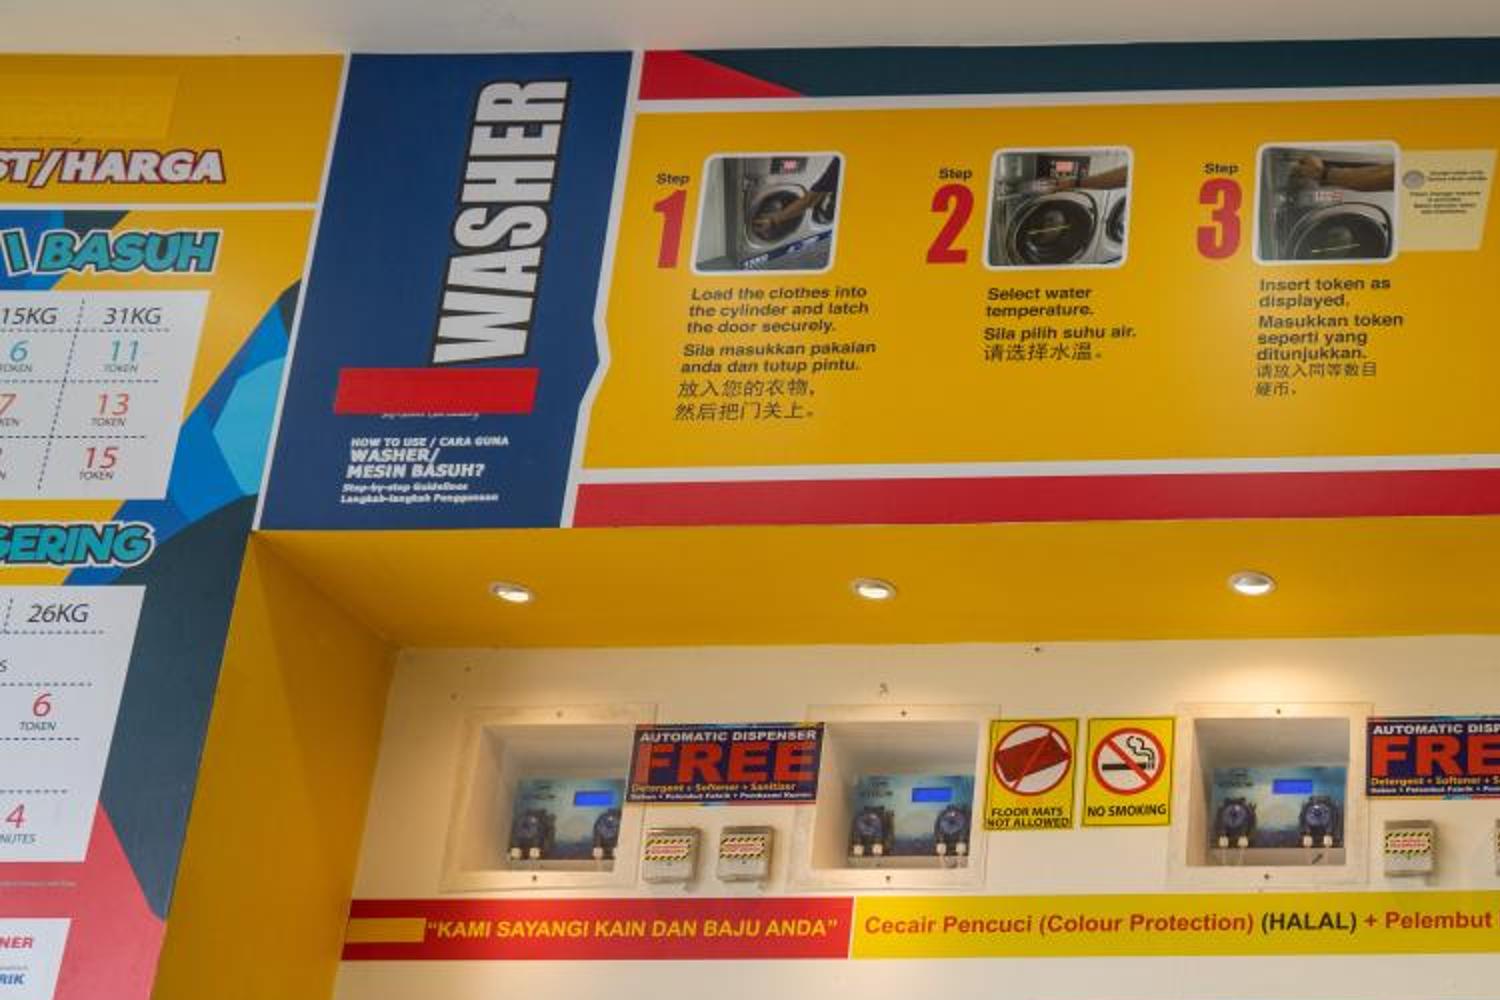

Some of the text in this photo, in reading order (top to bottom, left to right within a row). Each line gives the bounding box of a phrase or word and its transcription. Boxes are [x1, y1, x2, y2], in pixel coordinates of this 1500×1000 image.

[939, 168, 972, 180] Step
[1204, 164, 1239, 175] Step
[656, 173, 689, 187] Step
[431, 80, 569, 364] WASHER
[926, 183, 974, 264] 2
[1197, 178, 1243, 261] 3
[654, 189, 687, 268] 1
[35, 230, 221, 274] BASUH
[1260, 278, 1391, 291] Insert token as
[692, 286, 867, 300] Load the clothes into
[988, 288, 1091, 300] Select water
[1259, 294, 1349, 309] displayed.
[2, 308, 161, 325] 15KG 31KG
[689, 302, 868, 319] the cylinder and latch
[987, 305, 1093, 319] temperature.
[687, 321, 835, 335] the door securely.
[1259, 314, 1402, 328] Masukkan token
[984, 326, 1136, 342] Sila pilih suhu air.
[1258, 332, 1367, 346] seperti yang
[10, 340, 139, 362] 6 11
[684, 341, 876, 356] Sila masukkan pakaian
[1257, 348, 1366, 363] ditunjukkan.
[681, 357, 859, 374] anda dan tutup pintu.
[99, 393, 129, 415] 13
[352, 438, 381, 446] HOW
[384, 438, 400, 446] TO
[404, 437, 426, 446] USE
[440, 437, 471, 446] CARA
[475, 436, 509, 446] GUNA
[86, 448, 118, 468] 15
[352, 448, 440, 463] WASHER/
[80, 472, 114, 480] TOKEN
[346, 463, 485, 478] MESIN BASUH?
[28, 603, 89, 623] 26KG
[640, 730, 816, 742] AUTOMATIC DISPENSER
[1374, 724, 1463, 735] AUTOMATIC
[633, 741, 816, 784] FREE
[992, 807, 1063, 817] FLOOR MATS
[1088, 804, 1166, 817] NO SMOKING
[988, 817, 1069, 828] NOT ALLOWED
[497, 921, 589, 938] SAYANGI
[594, 920, 645, 937] KAIN
[651, 920, 697, 937] DAN
[704, 920, 760, 937] BAJU
[865, 916, 935, 935] Cecair
[943, 915, 1033, 934] Pencuci
[1039, 913, 1122, 936] (Colour
[1130, 912, 1253, 935] Protection)
[1261, 911, 1357, 935] (HALAL)
[1364, 915, 1377, 929] +
[1386, 911, 1492, 929] Pelembut
